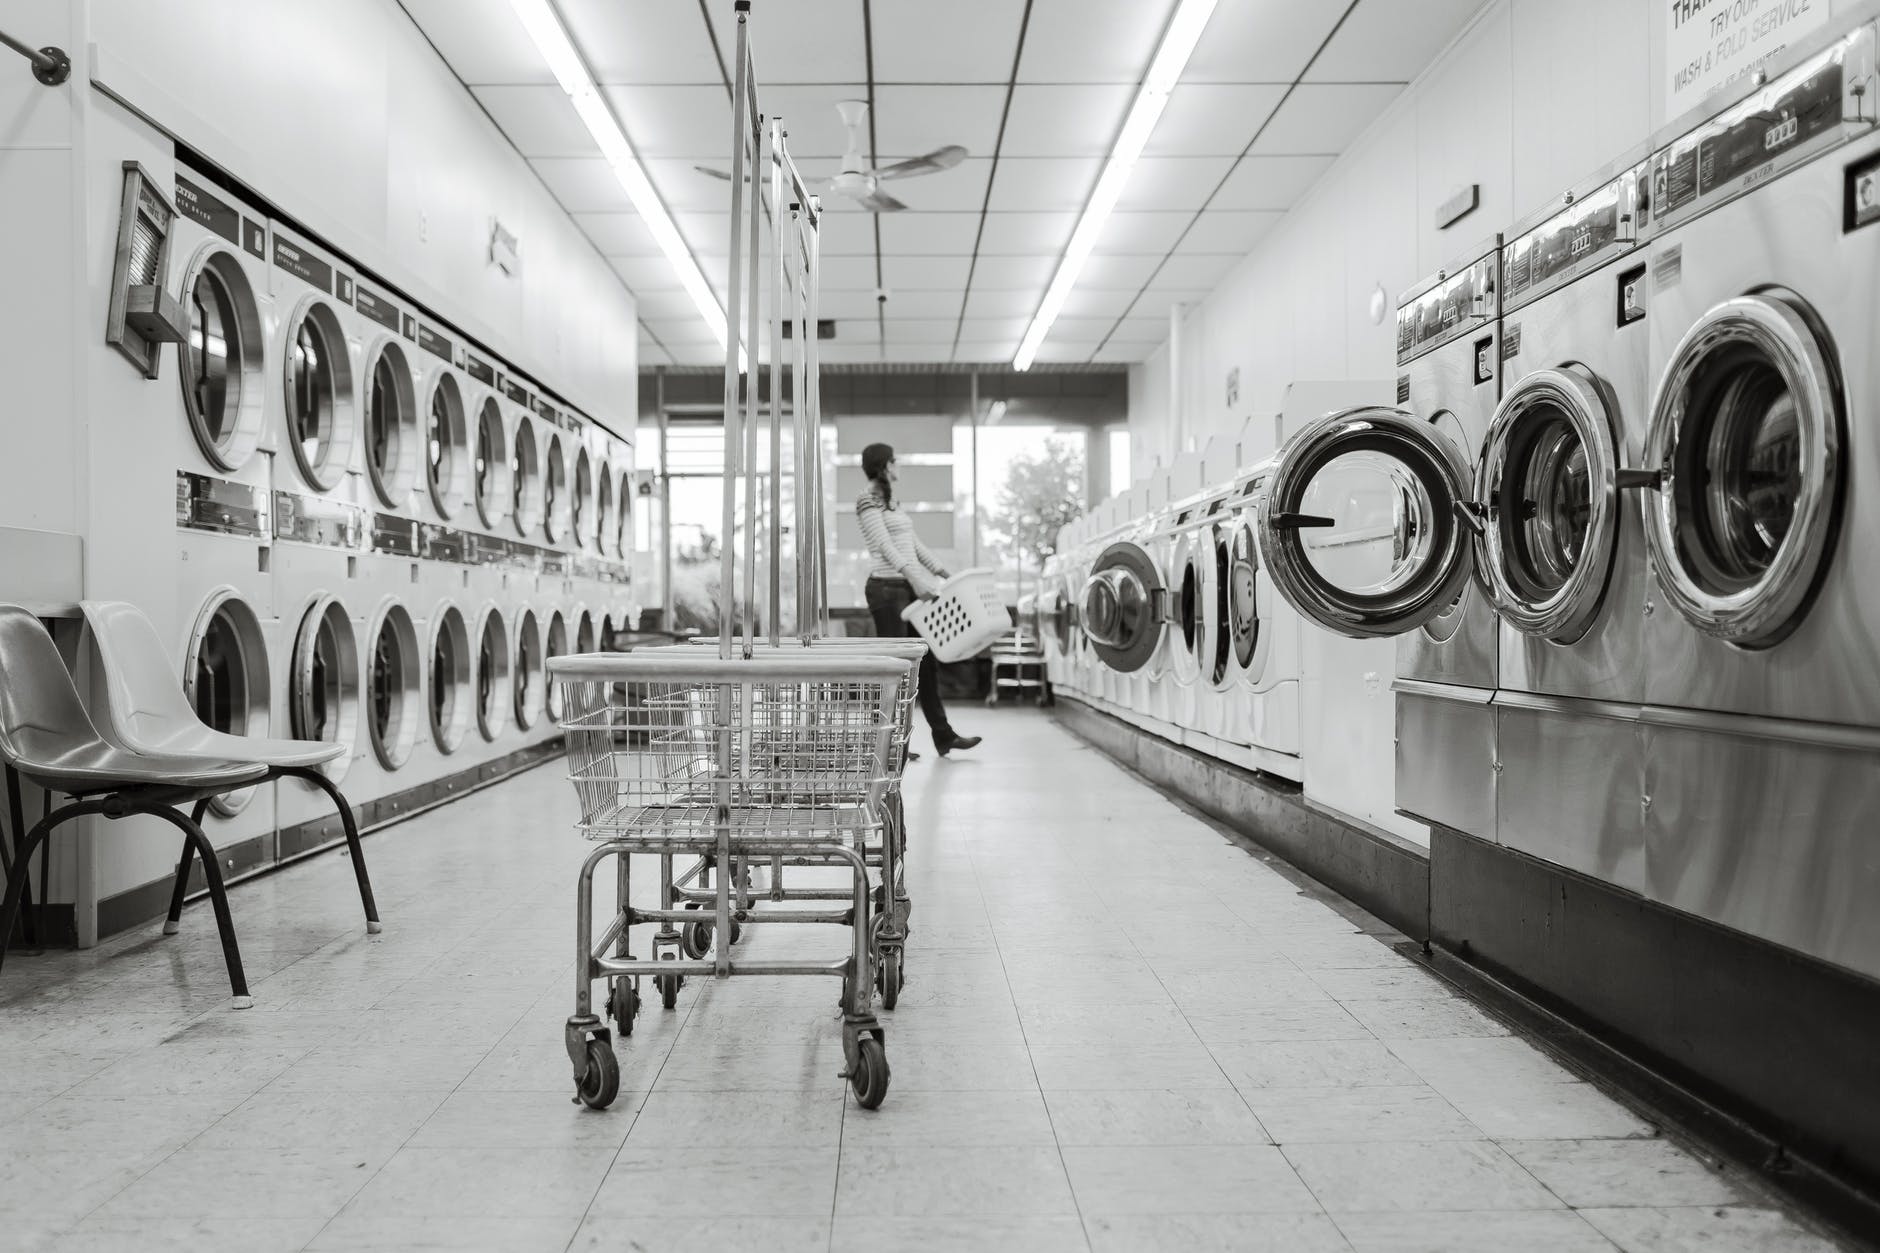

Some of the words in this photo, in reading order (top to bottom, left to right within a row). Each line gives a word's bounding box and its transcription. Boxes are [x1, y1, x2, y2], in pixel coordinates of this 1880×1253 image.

[1710, 2, 1733, 39] TRY
[1674, 56, 1702, 94] WASH
[1704, 50, 1711, 73] &
[1715, 26, 1747, 66] FOLD
